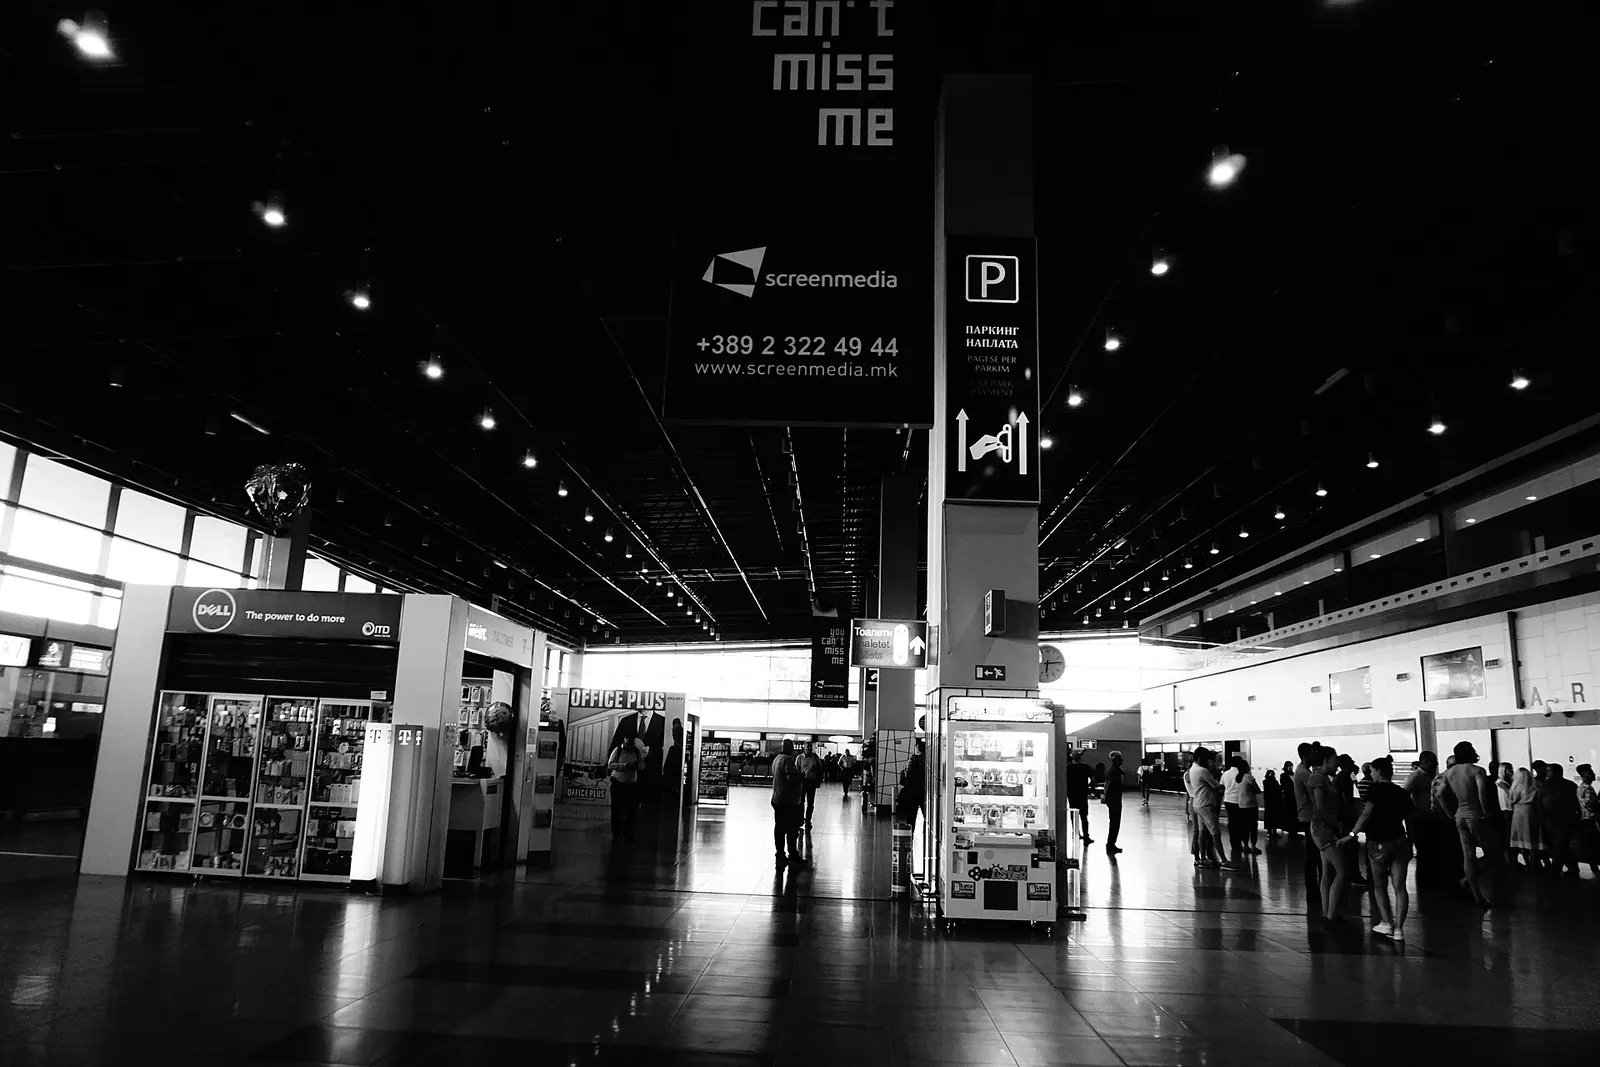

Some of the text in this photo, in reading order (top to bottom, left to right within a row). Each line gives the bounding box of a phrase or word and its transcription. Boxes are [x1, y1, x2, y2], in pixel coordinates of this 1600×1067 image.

[752, 0, 894, 37] can't
[772, 41, 894, 91] miss
[818, 108, 894, 146] me
[765, 270, 898, 289] screenmedia
[981, 261, 1006, 299] P
[965, 325, 1020, 336] ПАРКИНГ
[696, 335, 899, 358] +389 2 322 49 44
[966, 338, 1019, 349] НАПЛАТА
[1001, 355, 1017, 365] PER
[694, 362, 899, 378] www.screenmedia.mk
[974, 364, 1011, 374] PARKIM
[197, 604, 231, 616] DELL
[245, 611, 346, 624] The power to do more
[829, 628, 845, 638] you
[821, 636, 845, 646] can't
[824, 646, 845, 656] miss
[831, 656, 844, 665] me
[571, 688, 665, 710] OFFICE PLUS
[567, 788, 606, 799] OFFICE PLUS
